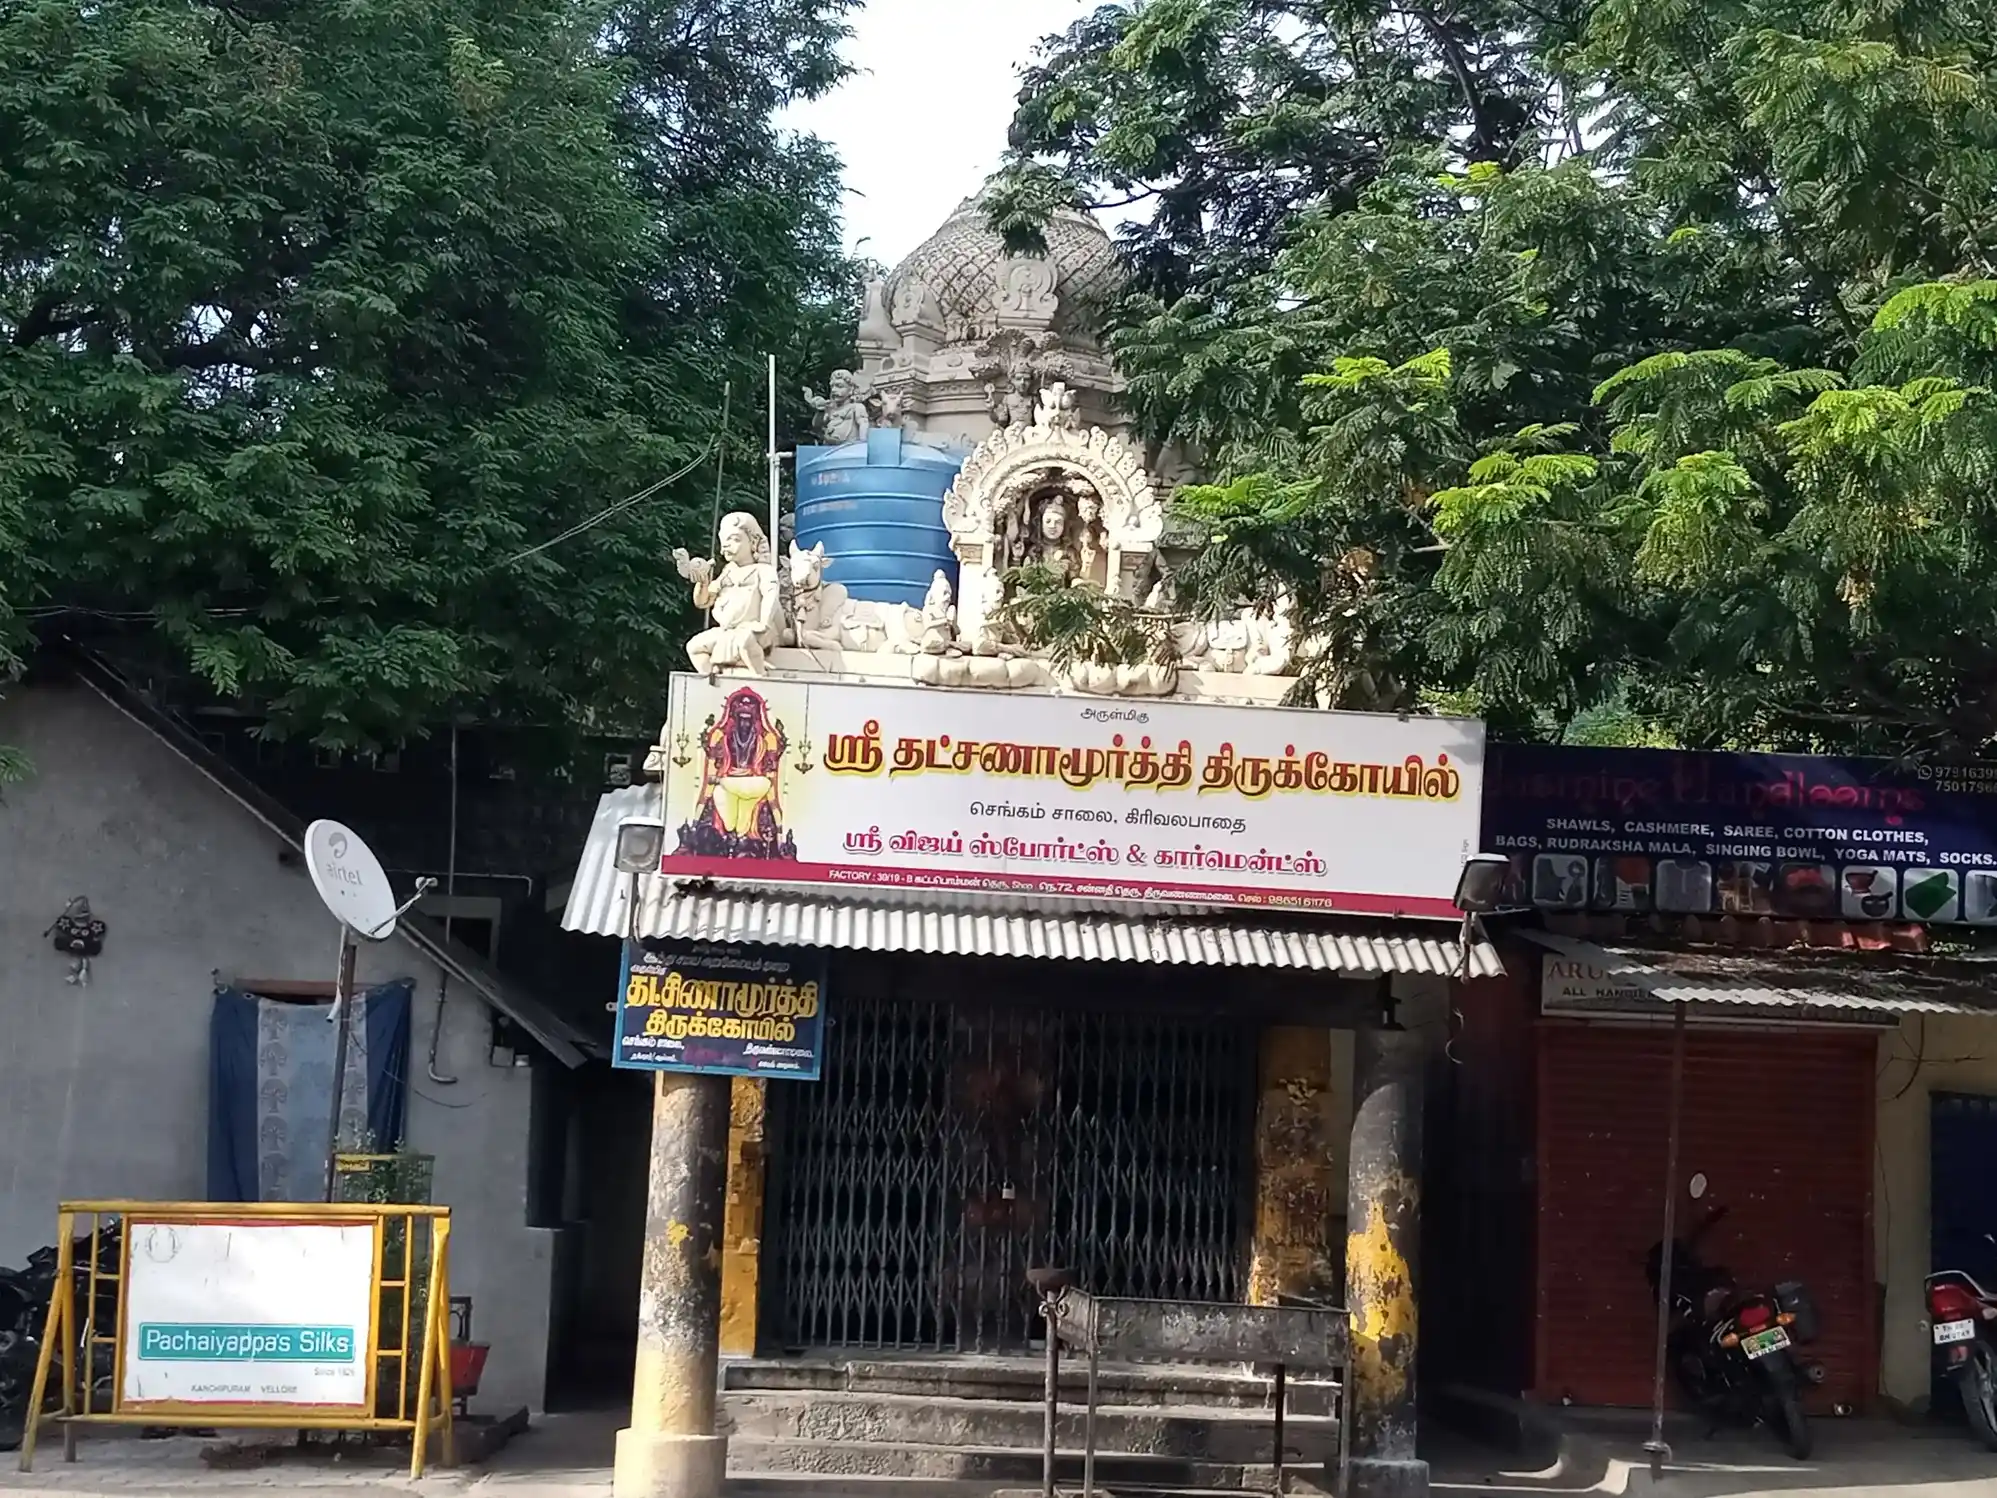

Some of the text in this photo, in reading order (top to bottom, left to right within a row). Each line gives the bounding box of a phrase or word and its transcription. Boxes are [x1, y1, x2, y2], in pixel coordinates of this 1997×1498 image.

[1080, 707, 1149, 724] அருள்மிகு
[888, 733, 1193, 791] தட்சணாமூர்த்தி
[1197, 741, 1460, 799] திருக்கோயில்
[969, 800, 1046, 819] செங்கம்
[1124, 807, 1247, 835] கிரிவலபாதை
[1546, 818, 1930, 846] SHAWLS, CASHMERE, SAREE, COTTON CLOTHES,
[888, 830, 963, 856] விஜய்
[969, 832, 1120, 865] ஸ்போர்ட்ஸ்
[1126, 844, 1148, 866] &
[1153, 844, 1328, 877] கார்மென்ட்ஸ்
[1495, 835, 1543, 850] BAGS,
[1547, 837, 1644, 853] RUDRAKSHA
[1649, 841, 1697, 856] MALA,
[1706, 843, 1772, 858] SINGING
[1776, 846, 1826, 861] BOWL,
[1835, 849, 1880, 862] YOGA
[1883, 850, 1931, 865] MATS,
[828, 869, 872, 881] FACTORY
[1562, 987, 1587, 997] ALL
[642, 1008, 796, 1042] திருக்கோயில்
[146, 1328, 350, 1357] Pachaiyappa's Silks
